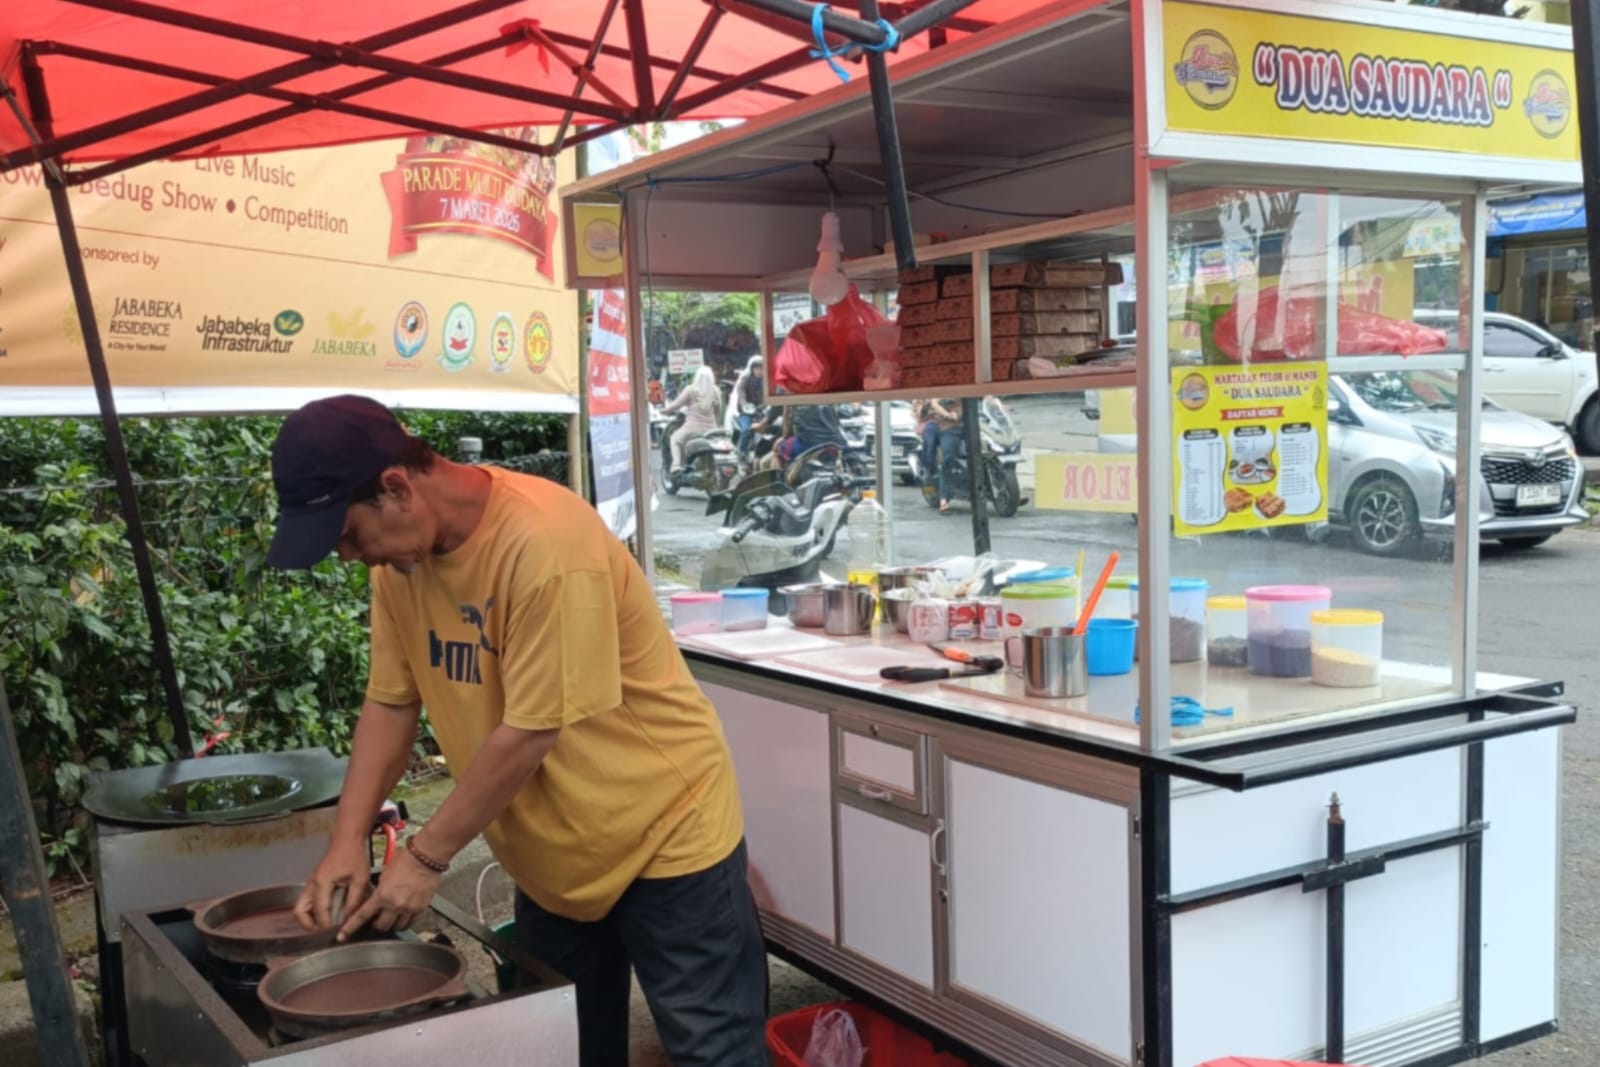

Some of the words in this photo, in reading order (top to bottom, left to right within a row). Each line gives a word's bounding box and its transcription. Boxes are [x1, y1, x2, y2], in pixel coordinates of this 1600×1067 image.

[1349, 53, 1495, 127] SAUDARA
[194, 155, 235, 176] Live
[242, 156, 296, 188] Music
[79, 171, 154, 211] Bedug
[161, 180, 217, 213] Show
[244, 195, 349, 235] Competition
[402, 166, 461, 193] PARADE
[465, 170, 501, 200] MULTI
[505, 186, 547, 223] BUDAYA
[440, 199, 449, 218] 7
[450, 199, 493, 224] MARET
[80, 247, 139, 264] onsored
[142, 250, 160, 270] by
[112, 297, 183, 320] JABABEKA
[109, 319, 171, 337] RESIDENCE
[196, 315, 271, 337] Jababeka
[202, 334, 294, 353] Infrastruktur
[312, 339, 377, 356] JABABEKA
[1231, 388, 1253, 399] DUA
[1254, 385, 1302, 398] SAUDARA
[1226, 409, 1257, 419] DAFTAR
[1258, 407, 1279, 417] MENU
